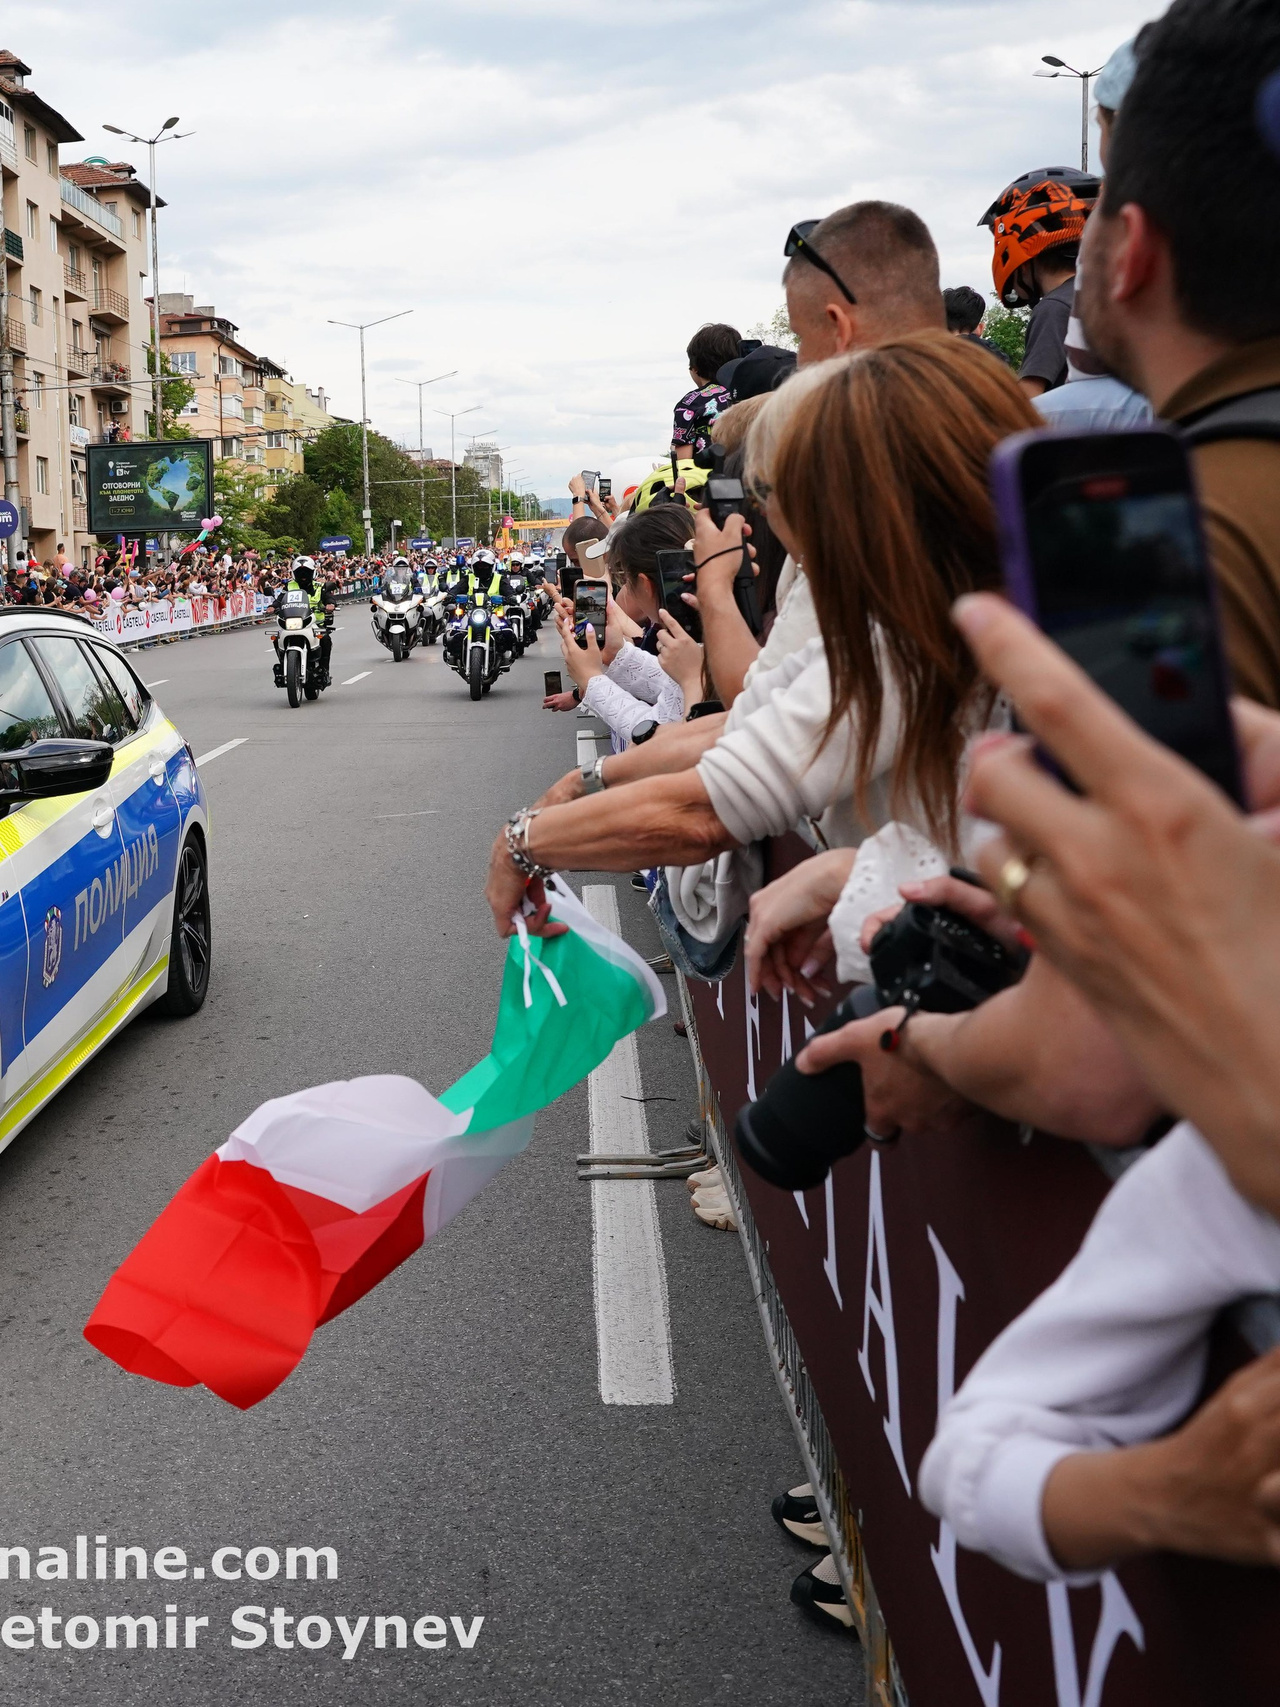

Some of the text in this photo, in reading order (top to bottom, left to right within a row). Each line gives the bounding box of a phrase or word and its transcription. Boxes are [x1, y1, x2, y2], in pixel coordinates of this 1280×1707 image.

[102, 481, 141, 490] ОТГОВОРНИ
[108, 494, 135, 502] ЗАЕДНО
[290, 594, 300, 602] 24
[281, 602, 308, 610] ПОЛИЦИЯ
[123, 614, 145, 628] CASTELLI
[73, 822, 159, 952] ПОЛИЦИЯ
